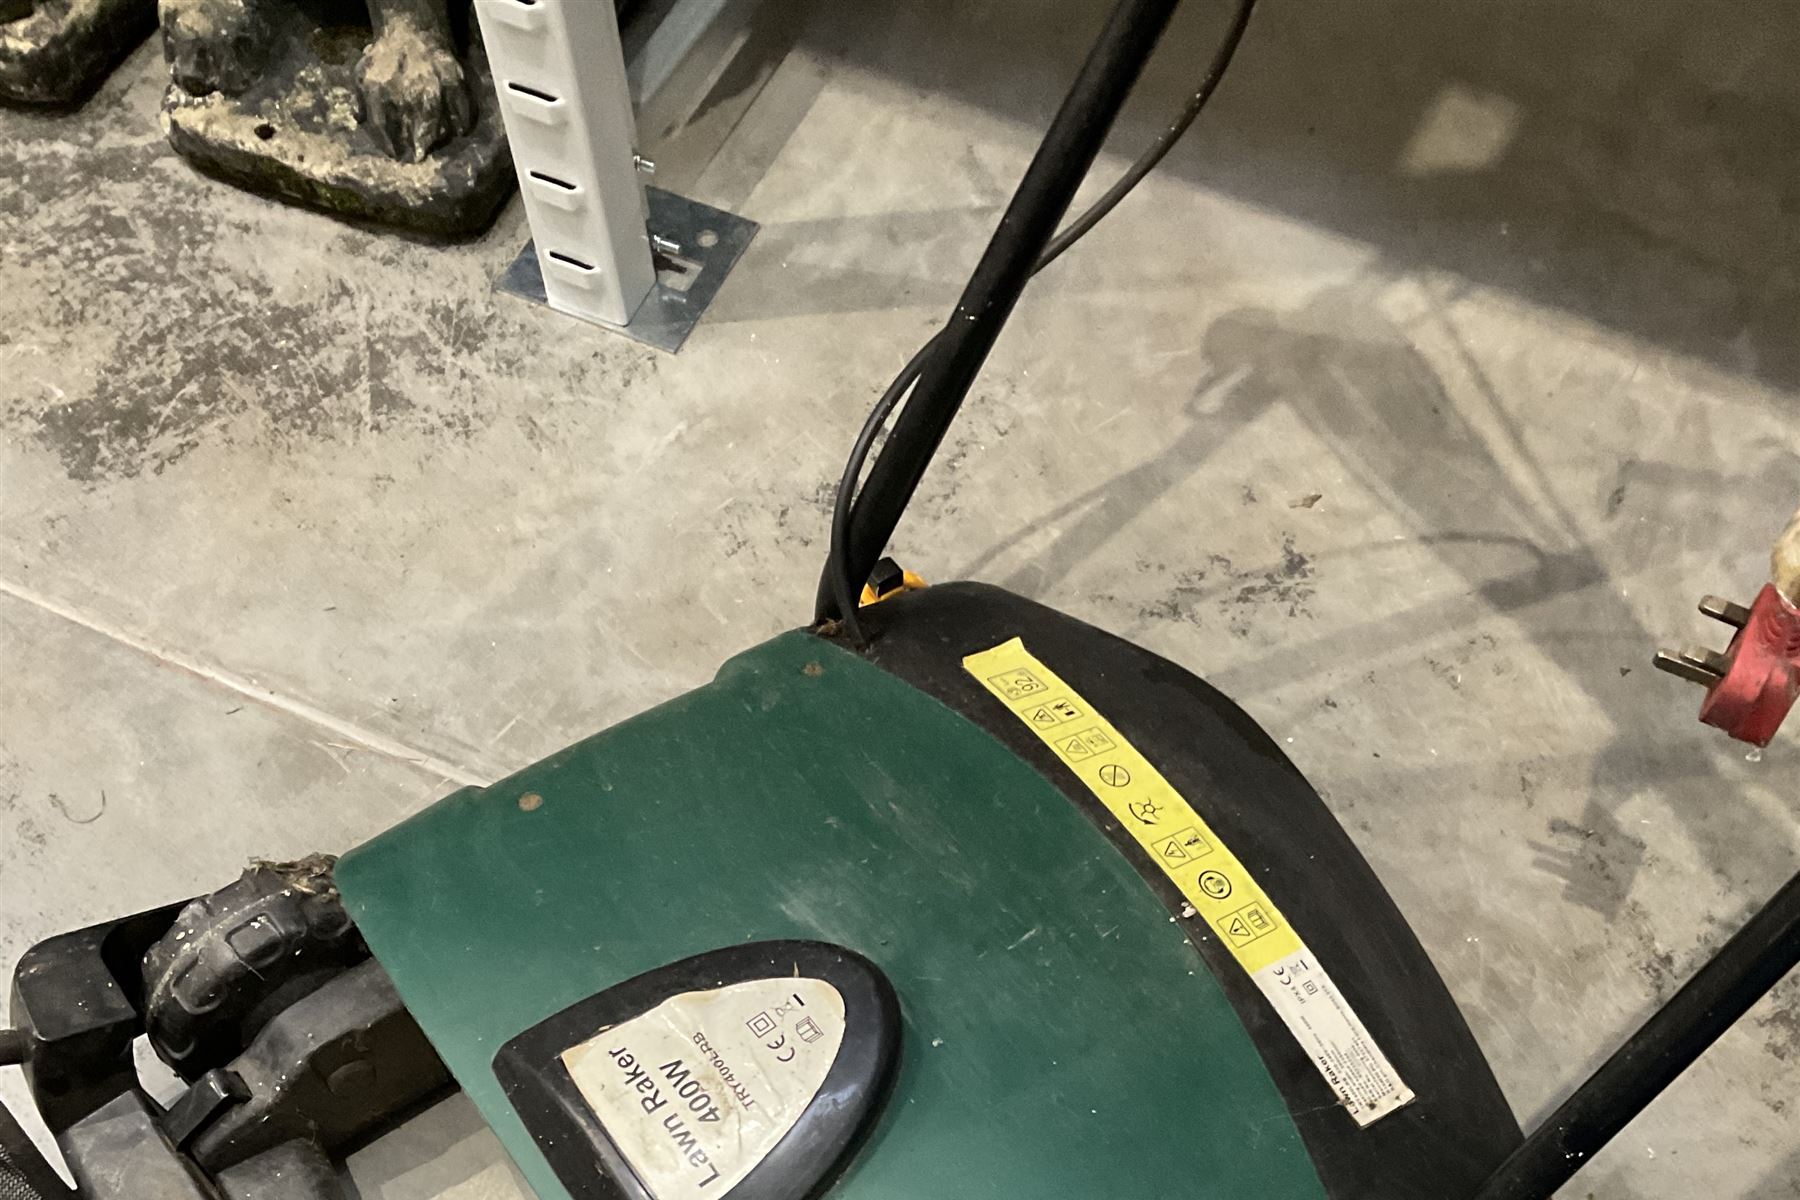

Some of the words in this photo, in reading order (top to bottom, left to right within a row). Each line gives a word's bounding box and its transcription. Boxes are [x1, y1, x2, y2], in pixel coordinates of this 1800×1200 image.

[1015, 676, 1039, 691] 92
[608, 1046, 667, 1114] Raker
[659, 1059, 721, 1123] 400W
[692, 1031, 755, 1111] TRY400LRB
[1318, 1055, 1340, 1085] Raker
[1340, 1086, 1359, 1115] Lawn
[664, 1112, 720, 1187] Lawn
